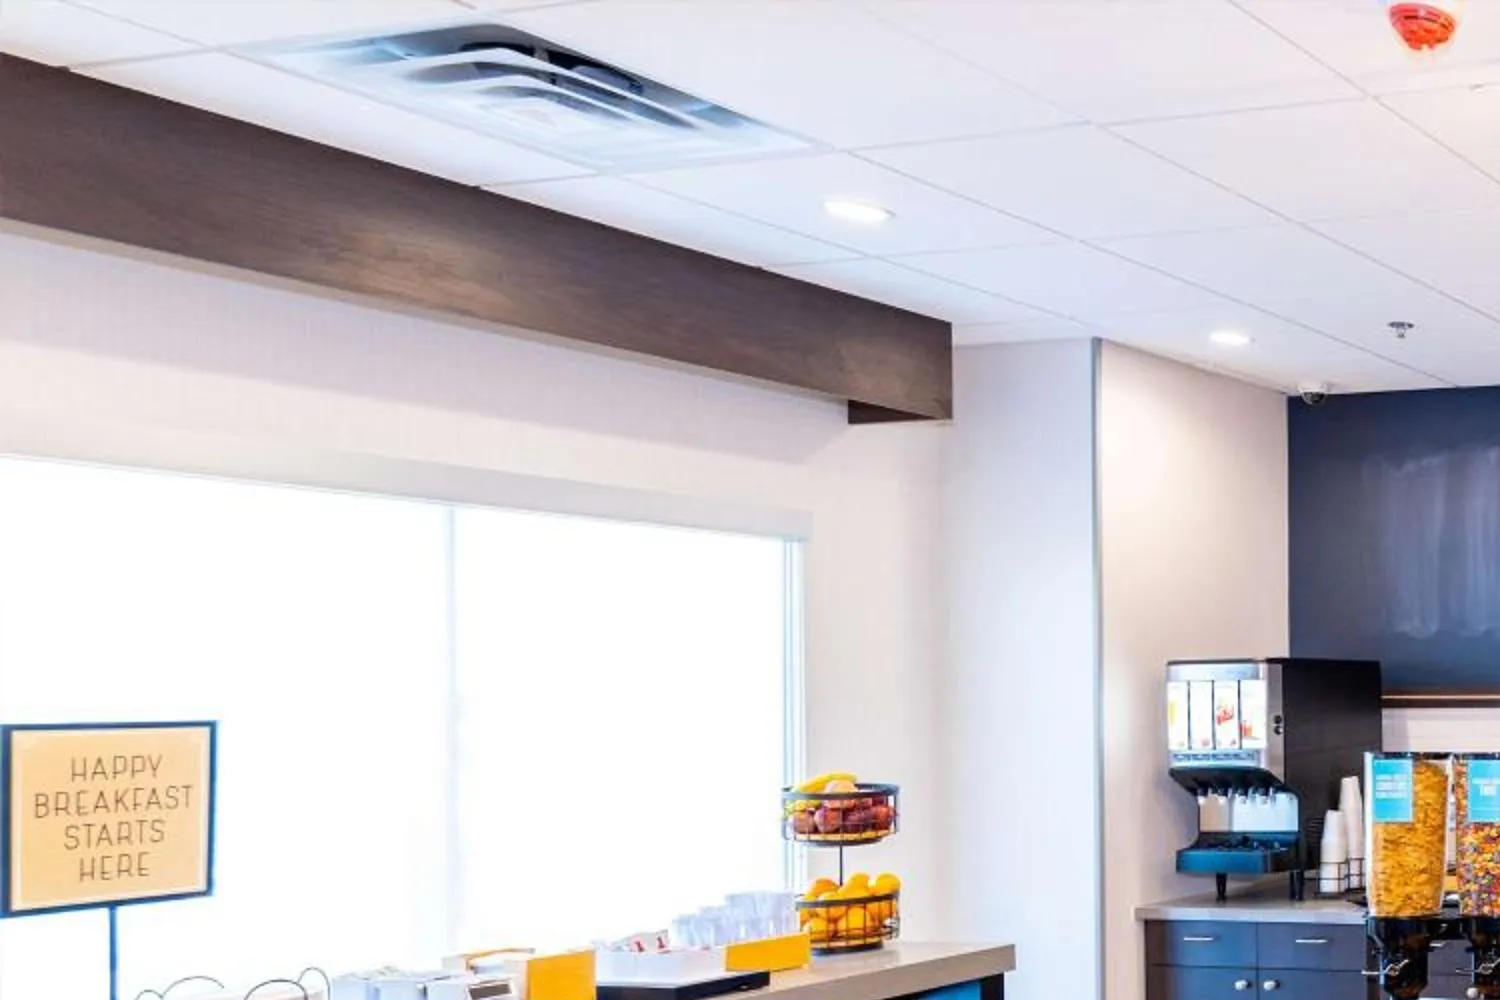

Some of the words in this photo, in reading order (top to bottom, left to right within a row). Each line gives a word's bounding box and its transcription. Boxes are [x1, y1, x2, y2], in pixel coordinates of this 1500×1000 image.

[70, 753, 163, 782] HAPPY
[34, 784, 194, 819] BREAKFAST
[63, 818, 167, 851] STARTS
[78, 851, 151, 882] HERE
